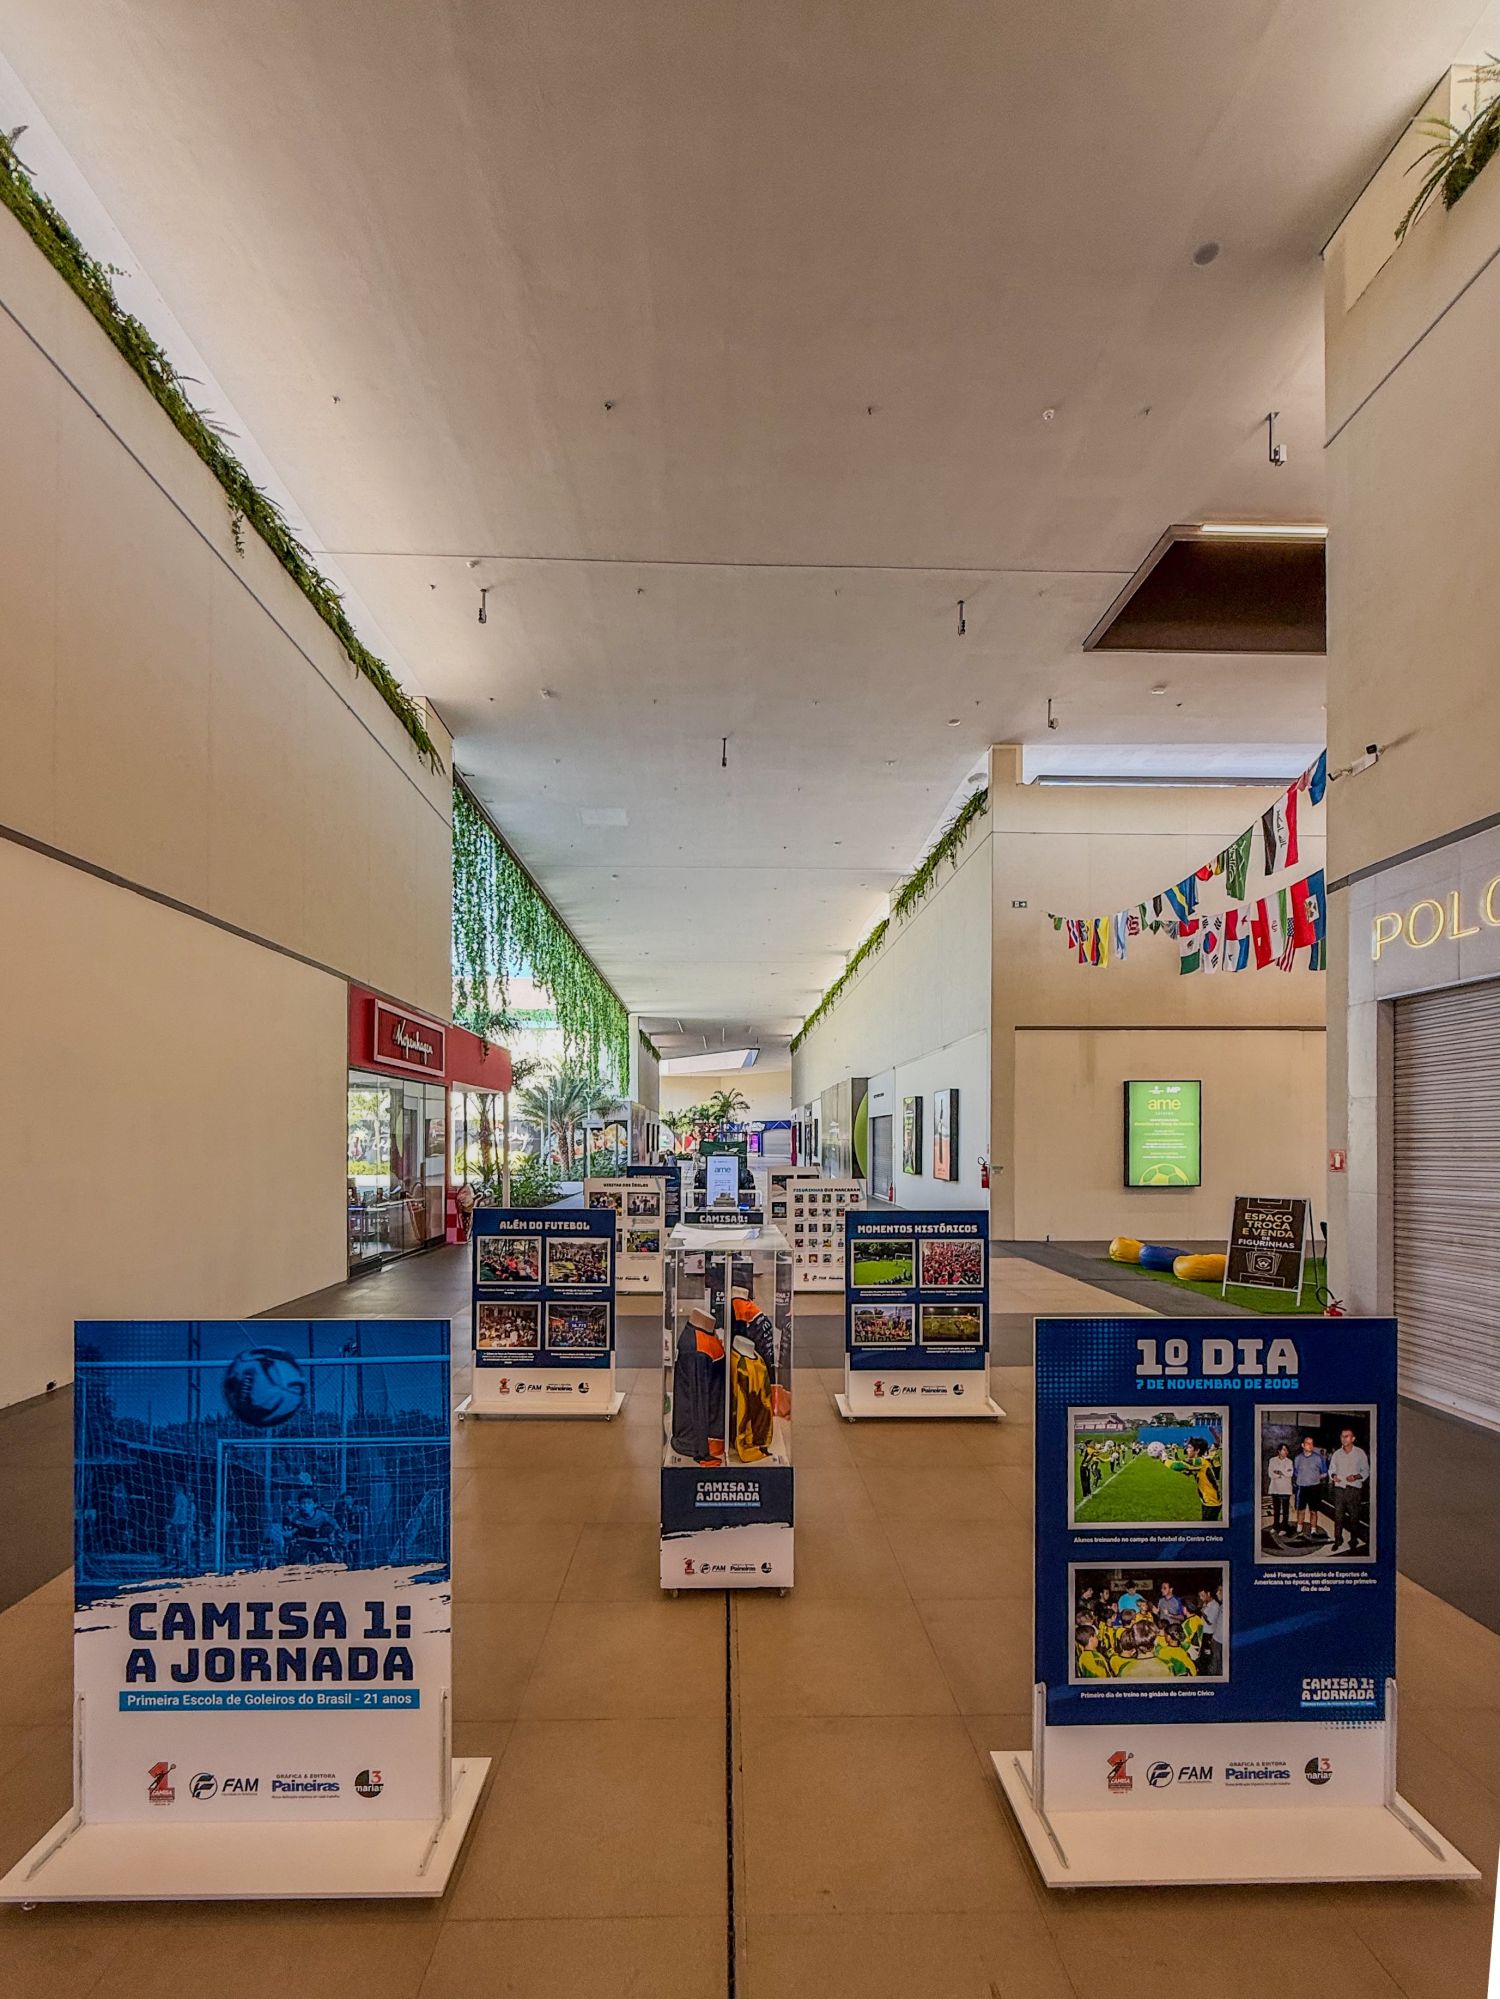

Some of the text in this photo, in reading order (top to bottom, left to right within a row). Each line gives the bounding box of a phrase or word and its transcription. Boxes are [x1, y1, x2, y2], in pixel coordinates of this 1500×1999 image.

[1148, 1099, 1181, 1110] ame
[1244, 1212, 1293, 1222] ESPAÇO
[500, 1219, 590, 1230] ALÉM DO FUTEBOL
[858, 1223, 978, 1234] MOMENTOS HISTÓRICOS
[1246, 1220, 1290, 1230] TROCA
[1252, 1228, 1294, 1238] VENDA
[1238, 1238, 1295, 1248] FIGURINHAS
[1202, 1338, 1298, 1375] DIA
[1136, 1378, 1298, 1390] 7 DE NOVEMBRO DE 2005
[697, 1482, 759, 1492] CAMISA 1:
[696, 1492, 760, 1501] A JORNADA
[129, 1601, 412, 1640] CAMISA 1:
[126, 1646, 414, 1683] A JORNADA
[1302, 1678, 1374, 1690] CAMISA 1:
[127, 1694, 180, 1706] Primeira
[182, 1694, 223, 1706] Escola
[226, 1694, 241, 1706] de
[244, 1693, 296, 1706] Goleiros
[298, 1693, 314, 1705] do
[317, 1693, 352, 1705] Brasil
[364, 1693, 378, 1704] 21
[382, 1695, 412, 1704] anos
[1302, 1690, 1374, 1700] A JORNADA
[1320, 1758, 1330, 1770] 3
[371, 1770, 382, 1784] 3
[1178, 1766, 1214, 1780] FAM
[1226, 1766, 1291, 1780] Paineiras
[222, 1778, 259, 1792] FAM
[272, 1780, 340, 1792] Paineiras
